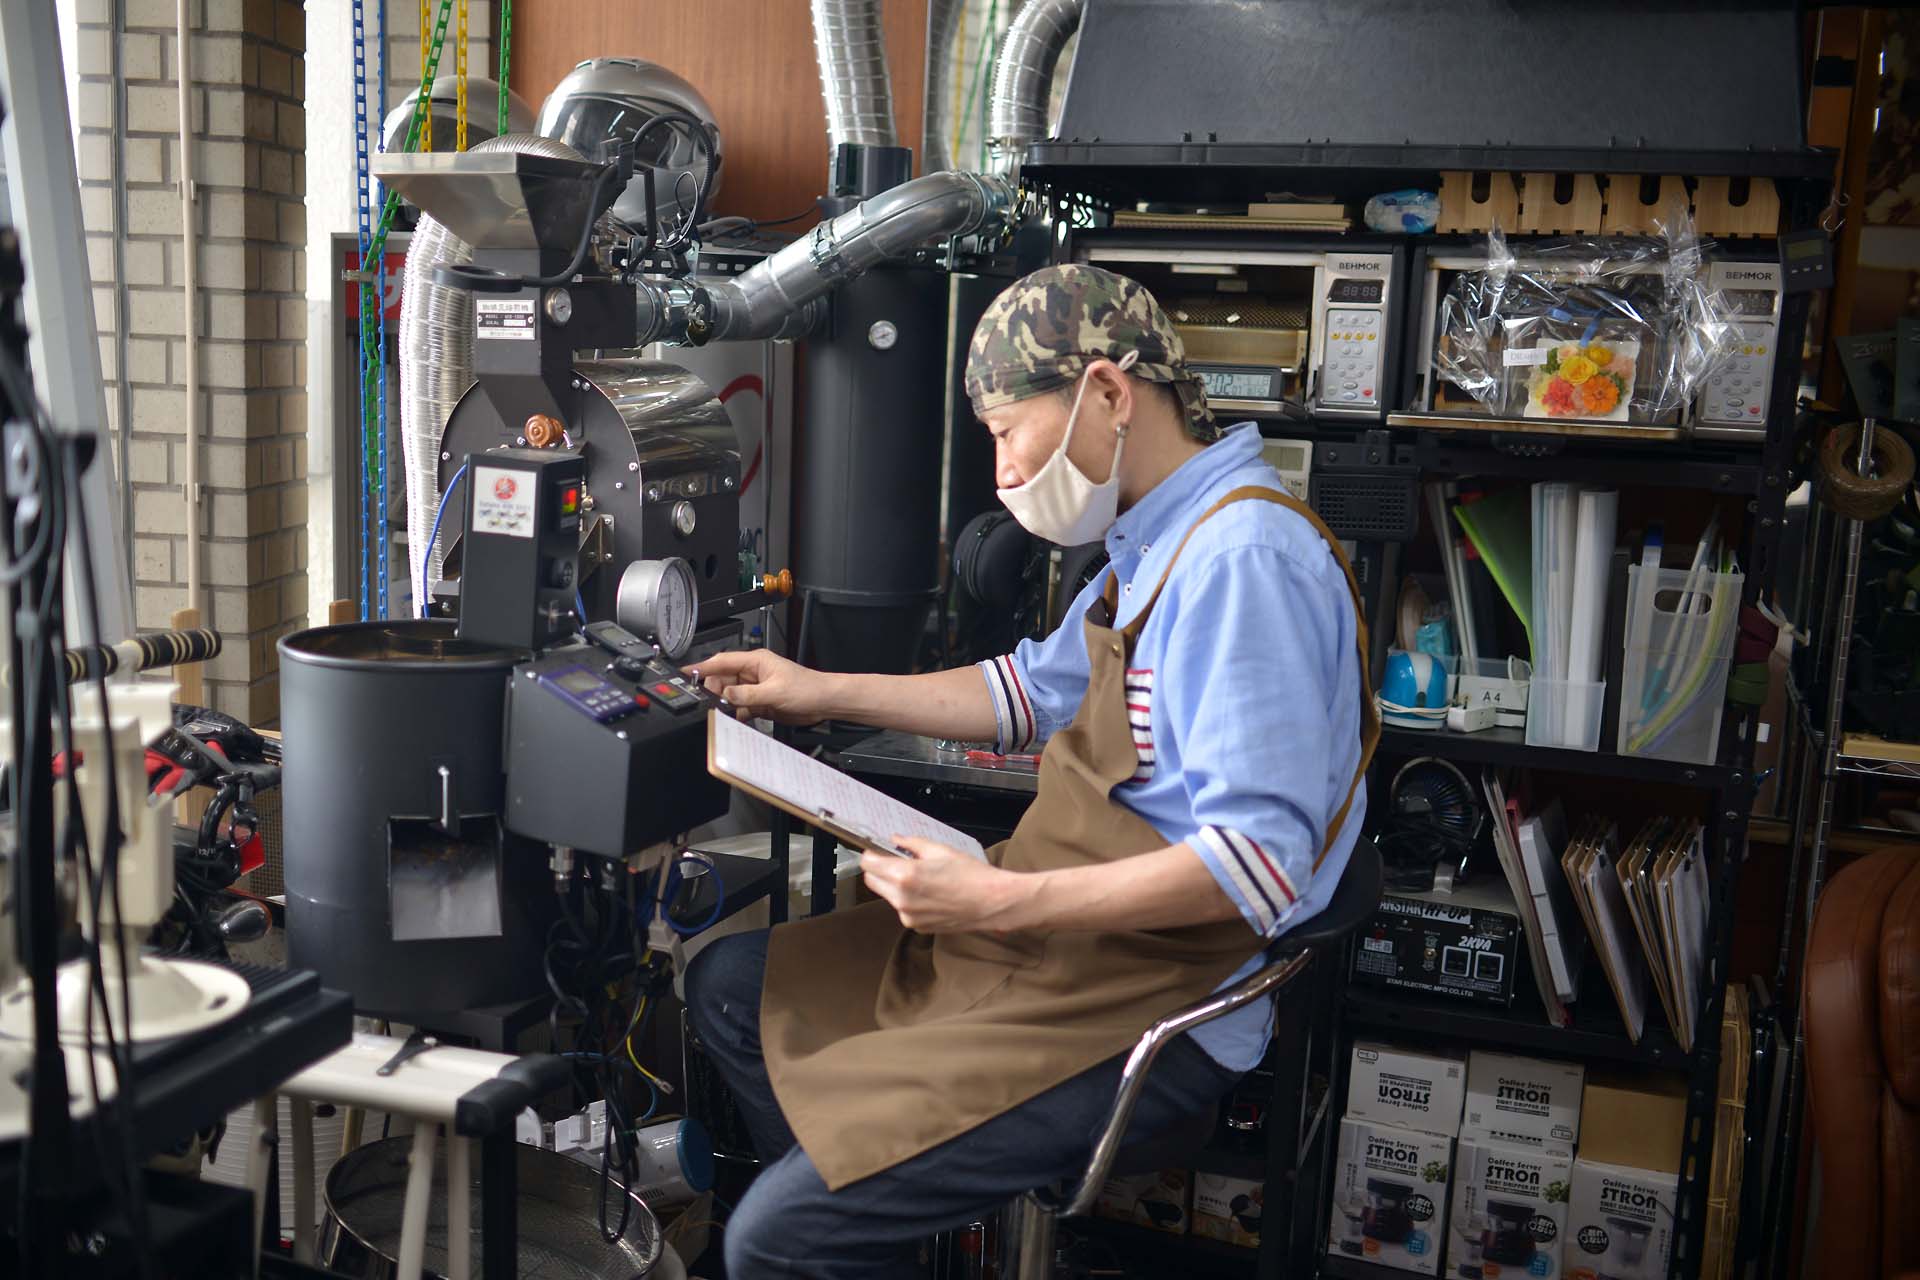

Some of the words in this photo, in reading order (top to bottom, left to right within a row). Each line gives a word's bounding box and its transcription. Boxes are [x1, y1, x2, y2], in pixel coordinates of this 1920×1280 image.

[1339, 262, 1380, 271] BEHMOR
[1726, 271, 1772, 281] BEHMOR
[1458, 935, 1492, 951] 2KVA
[1403, 979, 1433, 991] ELECTRIC
[1433, 985, 1448, 993] MFG
